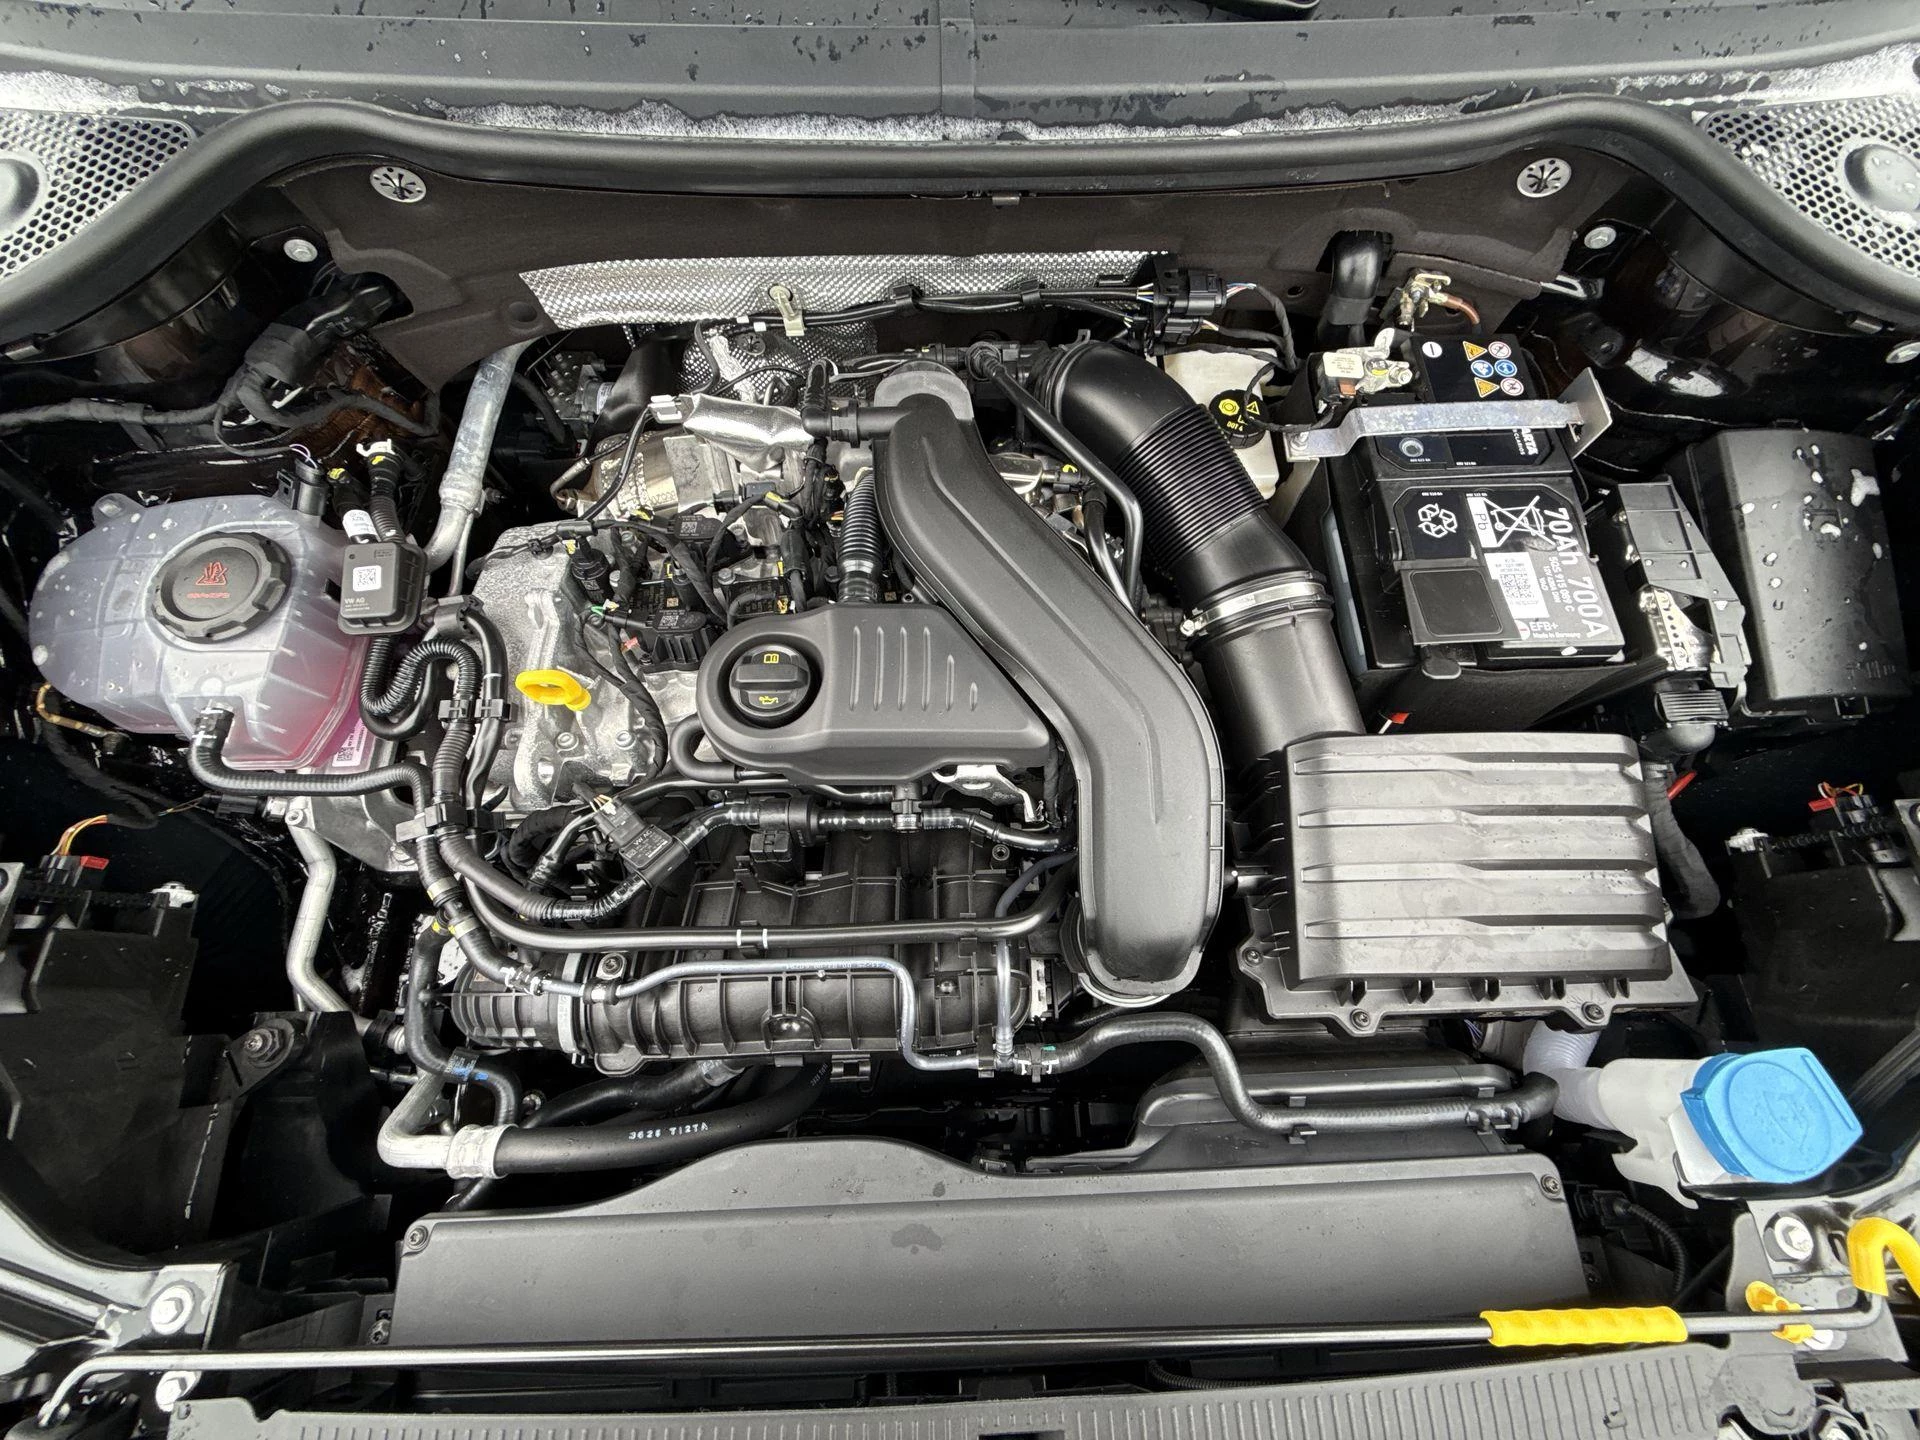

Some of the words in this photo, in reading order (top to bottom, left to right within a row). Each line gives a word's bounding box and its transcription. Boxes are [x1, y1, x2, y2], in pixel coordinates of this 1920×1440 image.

[1521, 427, 1539, 455] ARTA
[1474, 513, 1489, 530] Pb
[1543, 507, 1583, 565] 70Ah
[344, 597, 355, 605] VW
[1567, 576, 1610, 638] 700A
[1529, 621, 1559, 632] EFB+
